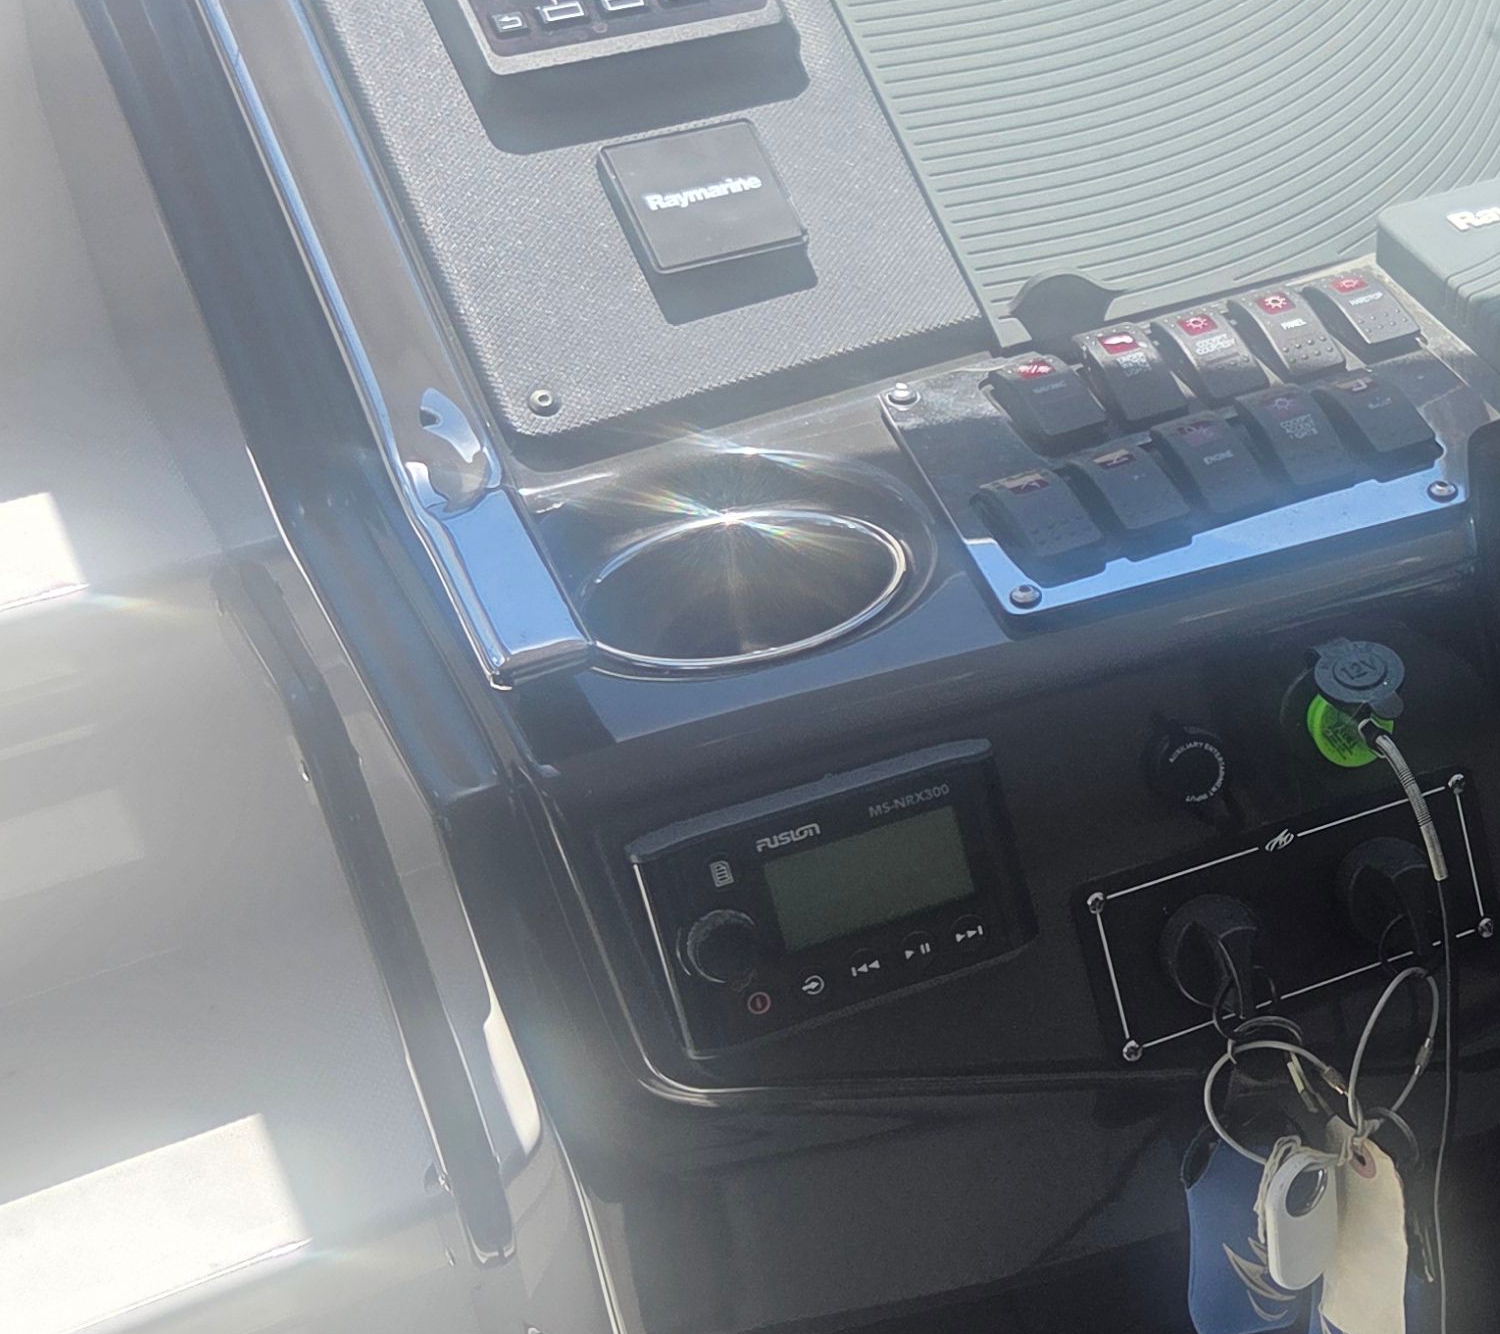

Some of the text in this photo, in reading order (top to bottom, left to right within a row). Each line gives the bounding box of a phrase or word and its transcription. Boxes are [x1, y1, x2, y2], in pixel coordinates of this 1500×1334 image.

[643, 175, 763, 212] Raymarine
[1168, 741, 1204, 763] AUXILIARY
[868, 783, 950, 818] MS-NRX300
[755, 822, 821, 853] FUSION
